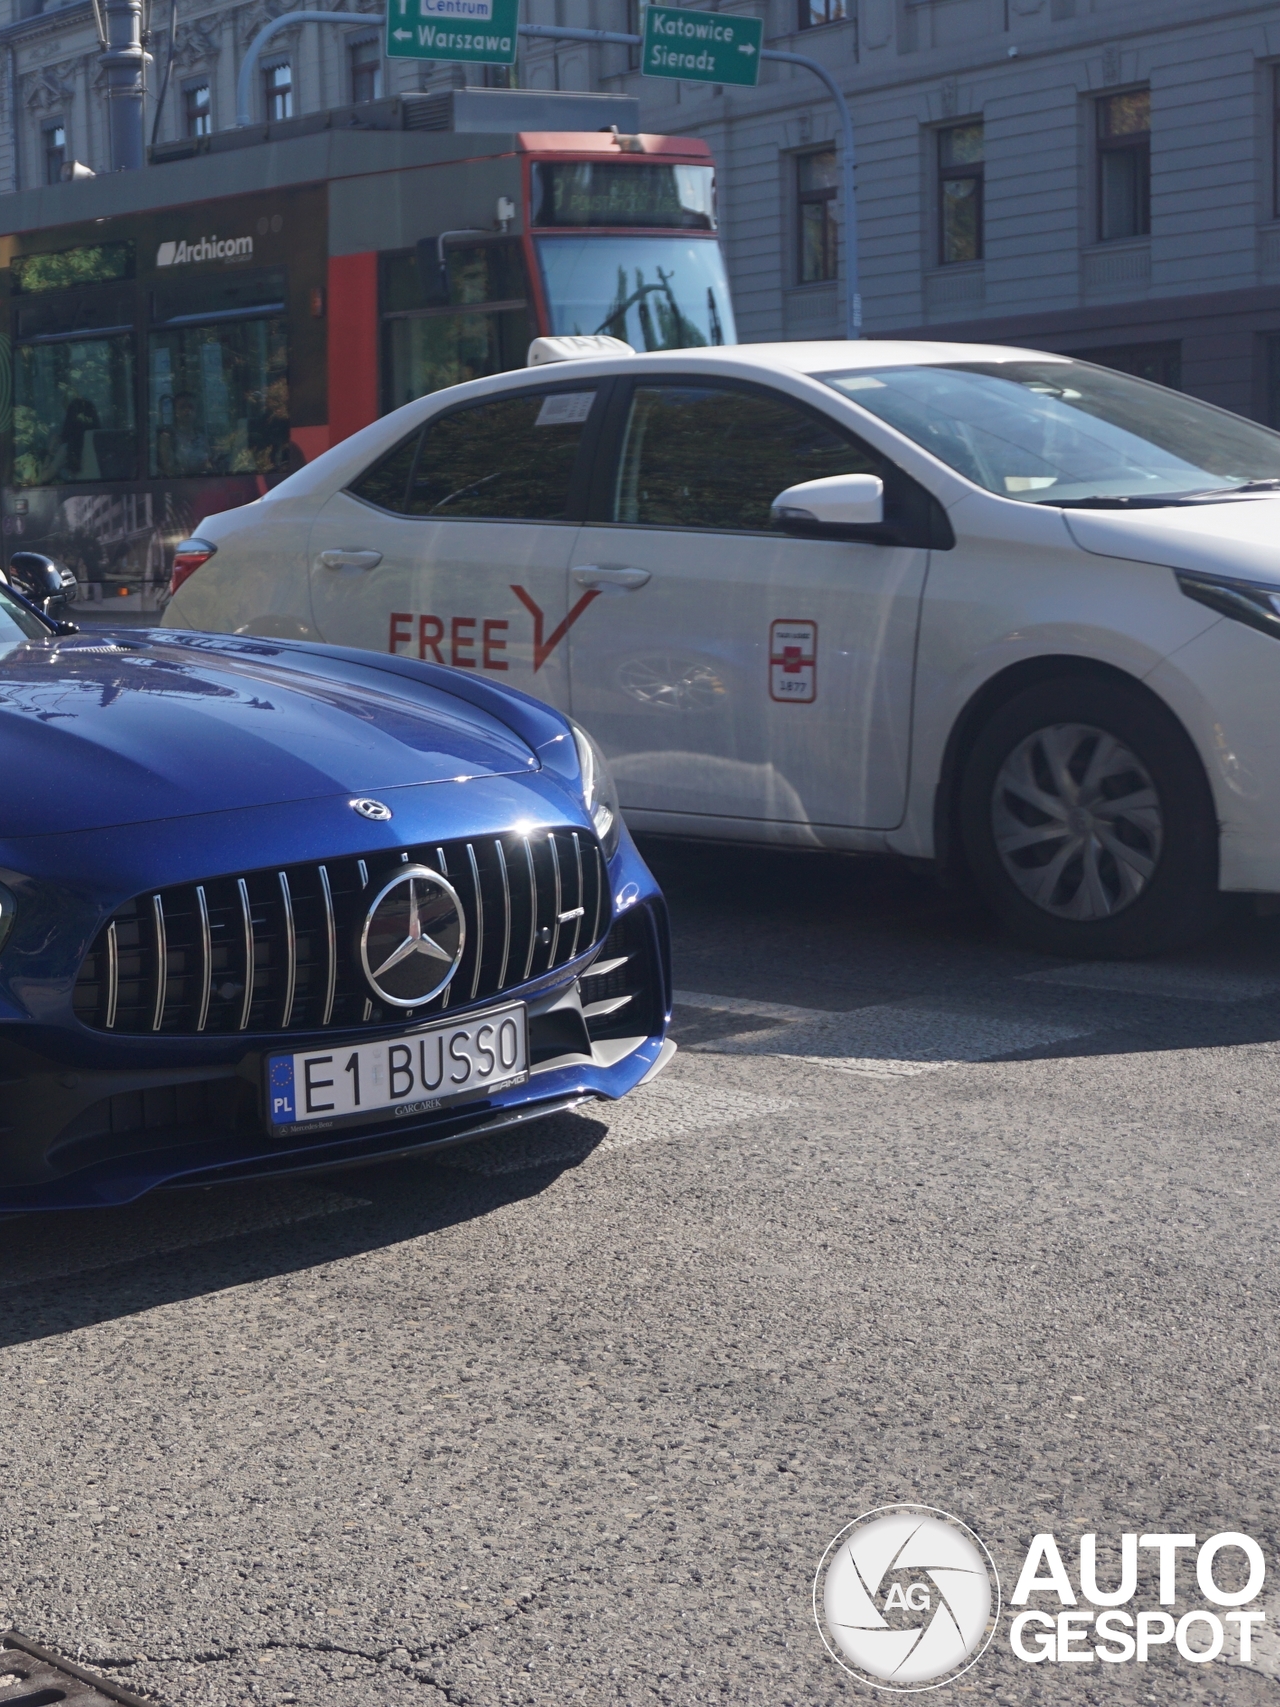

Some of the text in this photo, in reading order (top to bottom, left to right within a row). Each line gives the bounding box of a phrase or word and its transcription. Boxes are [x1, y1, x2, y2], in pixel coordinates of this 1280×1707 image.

[425, 0, 488, 15] Centrum
[653, 13, 734, 42] Katowice
[418, 25, 511, 51] Warszawa
[651, 45, 715, 71] Sieradz
[174, 235, 252, 263] Archicom
[546, 336, 625, 351] TAXI
[780, 681, 807, 692] 1877
[304, 1016, 518, 1113] E1 BUSSO
[499, 1074, 526, 1091] AMG
[274, 1097, 293, 1114] PL
[394, 1098, 442, 1117] GARCAREK
[290, 1121, 333, 1133] Mercedes-Benz
